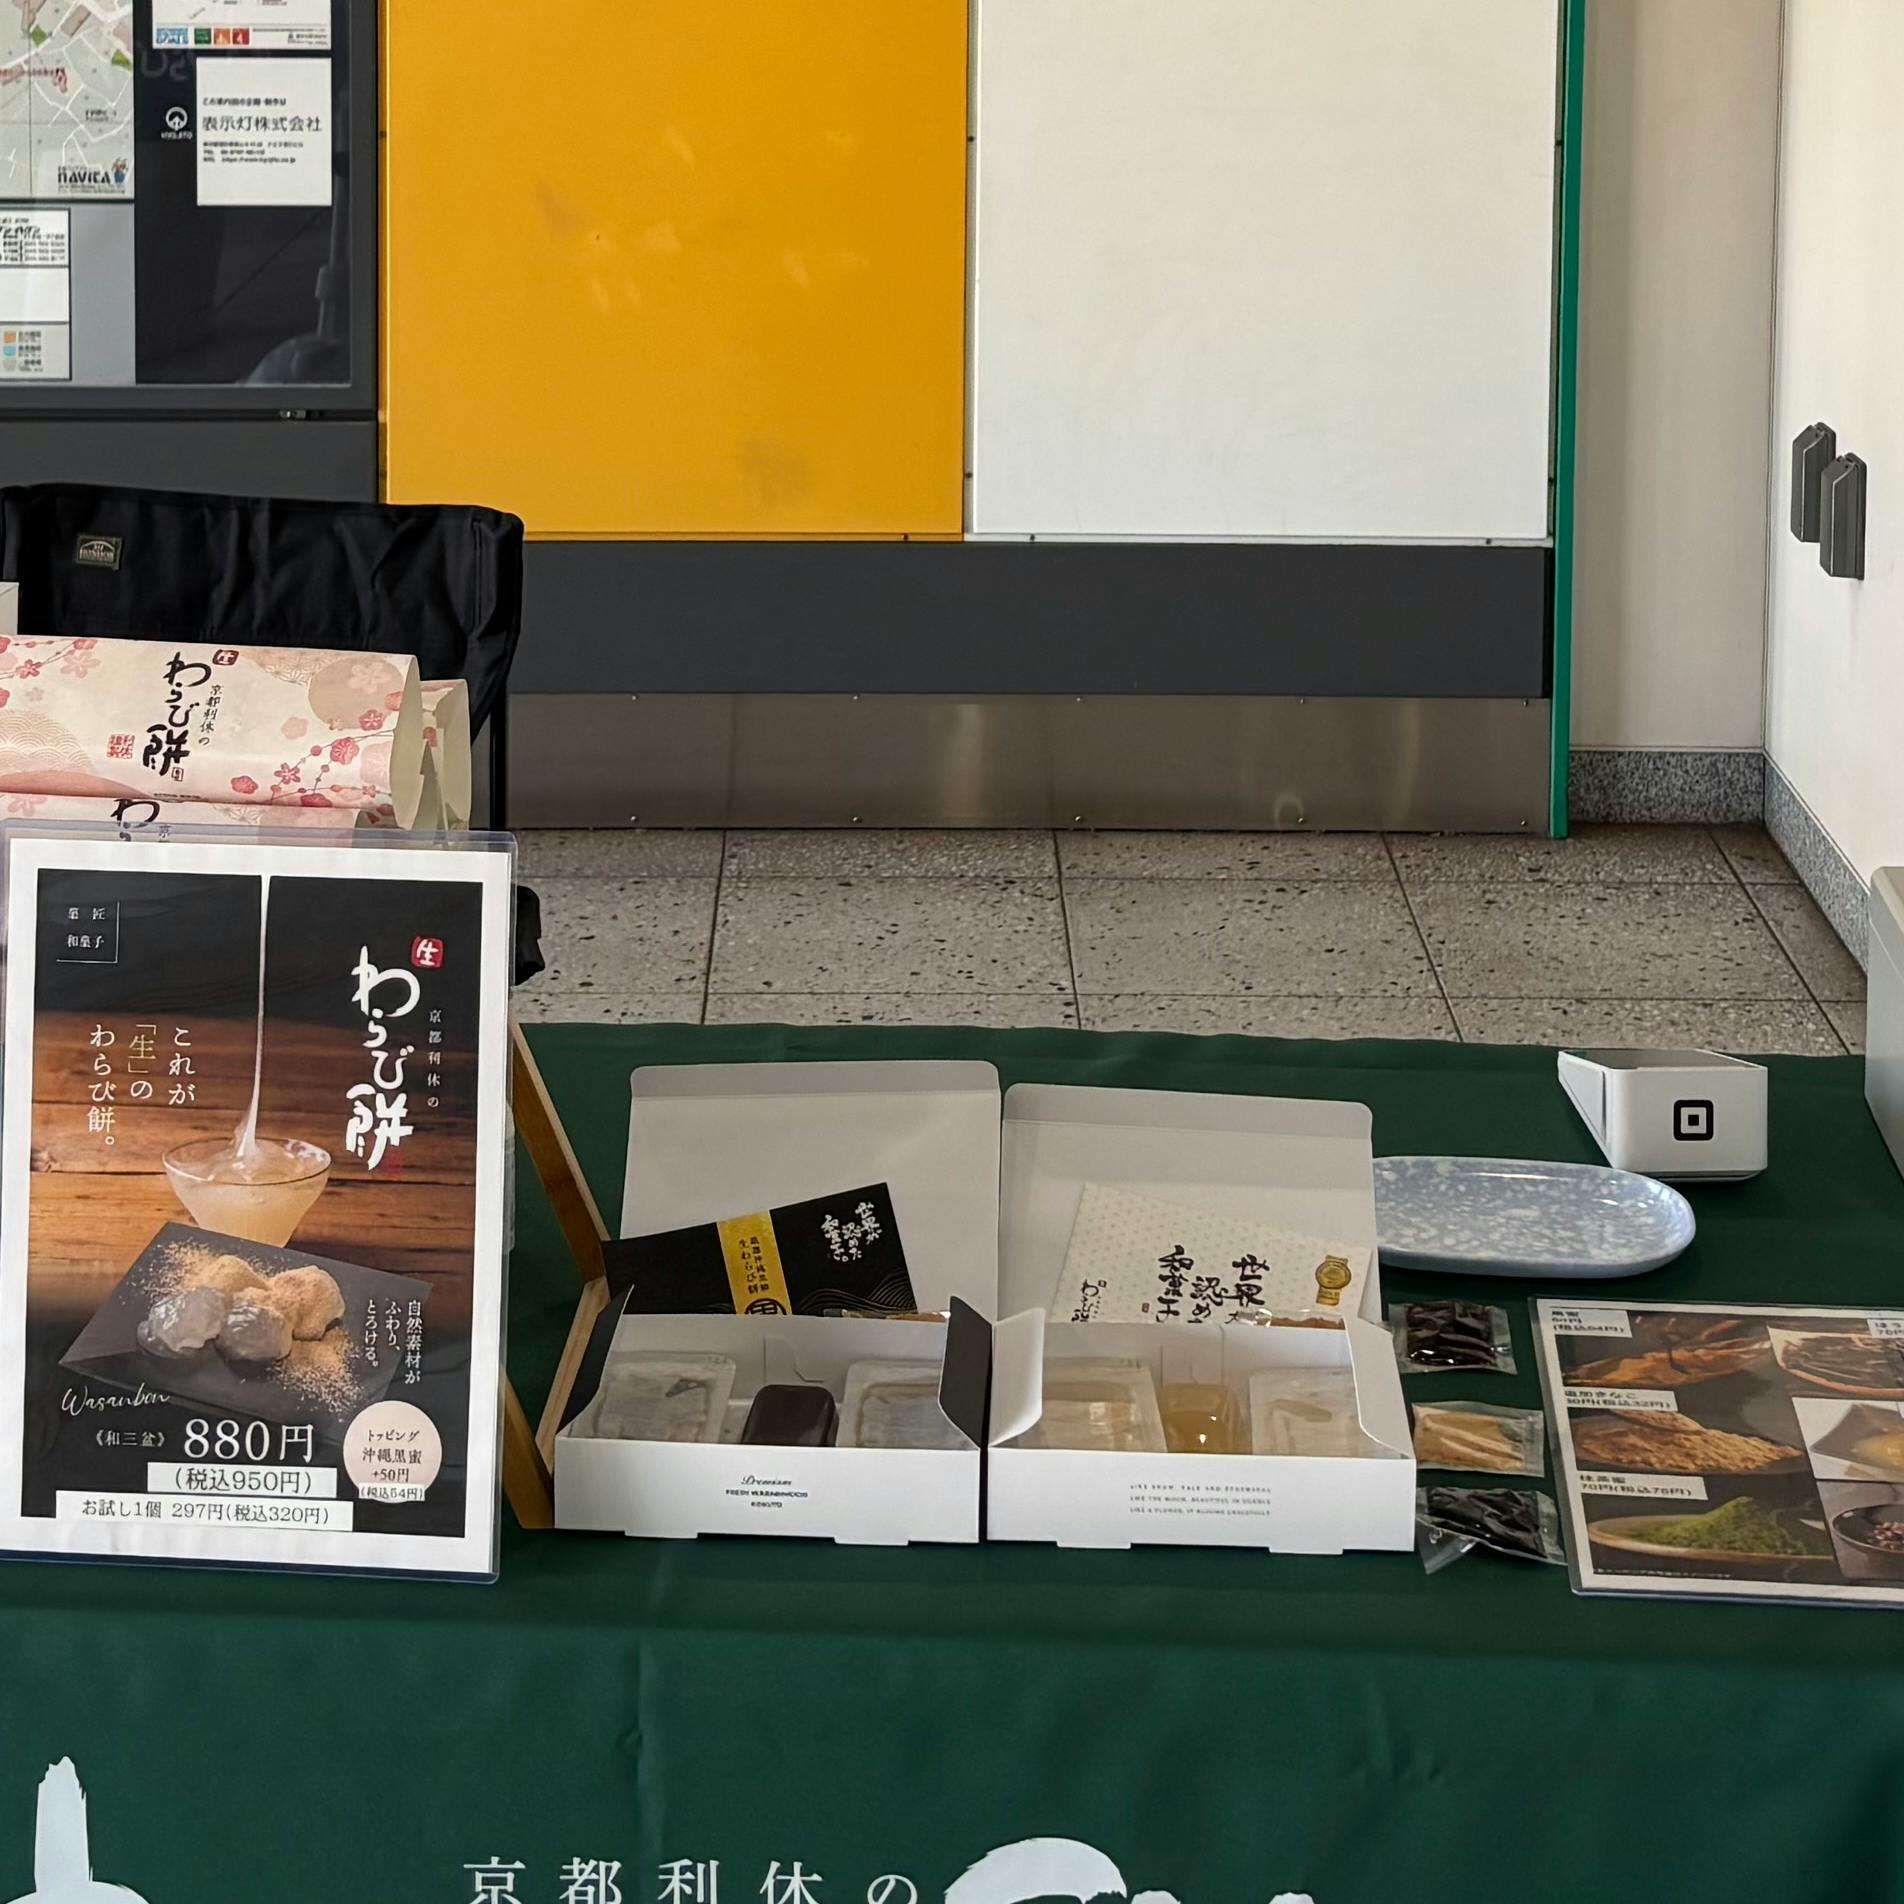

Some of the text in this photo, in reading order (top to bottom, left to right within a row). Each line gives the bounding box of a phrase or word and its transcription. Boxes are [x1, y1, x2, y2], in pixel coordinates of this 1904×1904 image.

[202, 116, 322, 133] 表示灯株式会社
[143, 651, 212, 776] わらび餅
[198, 684, 223, 746] 京都利休の
[67, 934, 105, 948] 和菓子
[128, 1022, 157, 1101] 「生」の
[167, 1027, 196, 1107] これが
[344, 944, 421, 1171] わらび餅
[427, 1010, 442, 1108] 京都利休の
[86, 1024, 117, 1147] わらび餅。
[364, 1301, 381, 1367] とろける。
[385, 1301, 402, 1352] ふわり、
[405, 1300, 424, 1384] 自然素材が
[182, 1418, 316, 1464] 880円
[361, 1447, 422, 1465] 沖縄黒蜜
[365, 1428, 420, 1444] トッピング
[172, 1468, 314, 1496] (税込950円)
[358, 1485, 426, 1501] (税込54円)
[371, 1467, 408, 1482] +50円
[81, 1498, 331, 1526] お試し1個 297円(税込320円)
